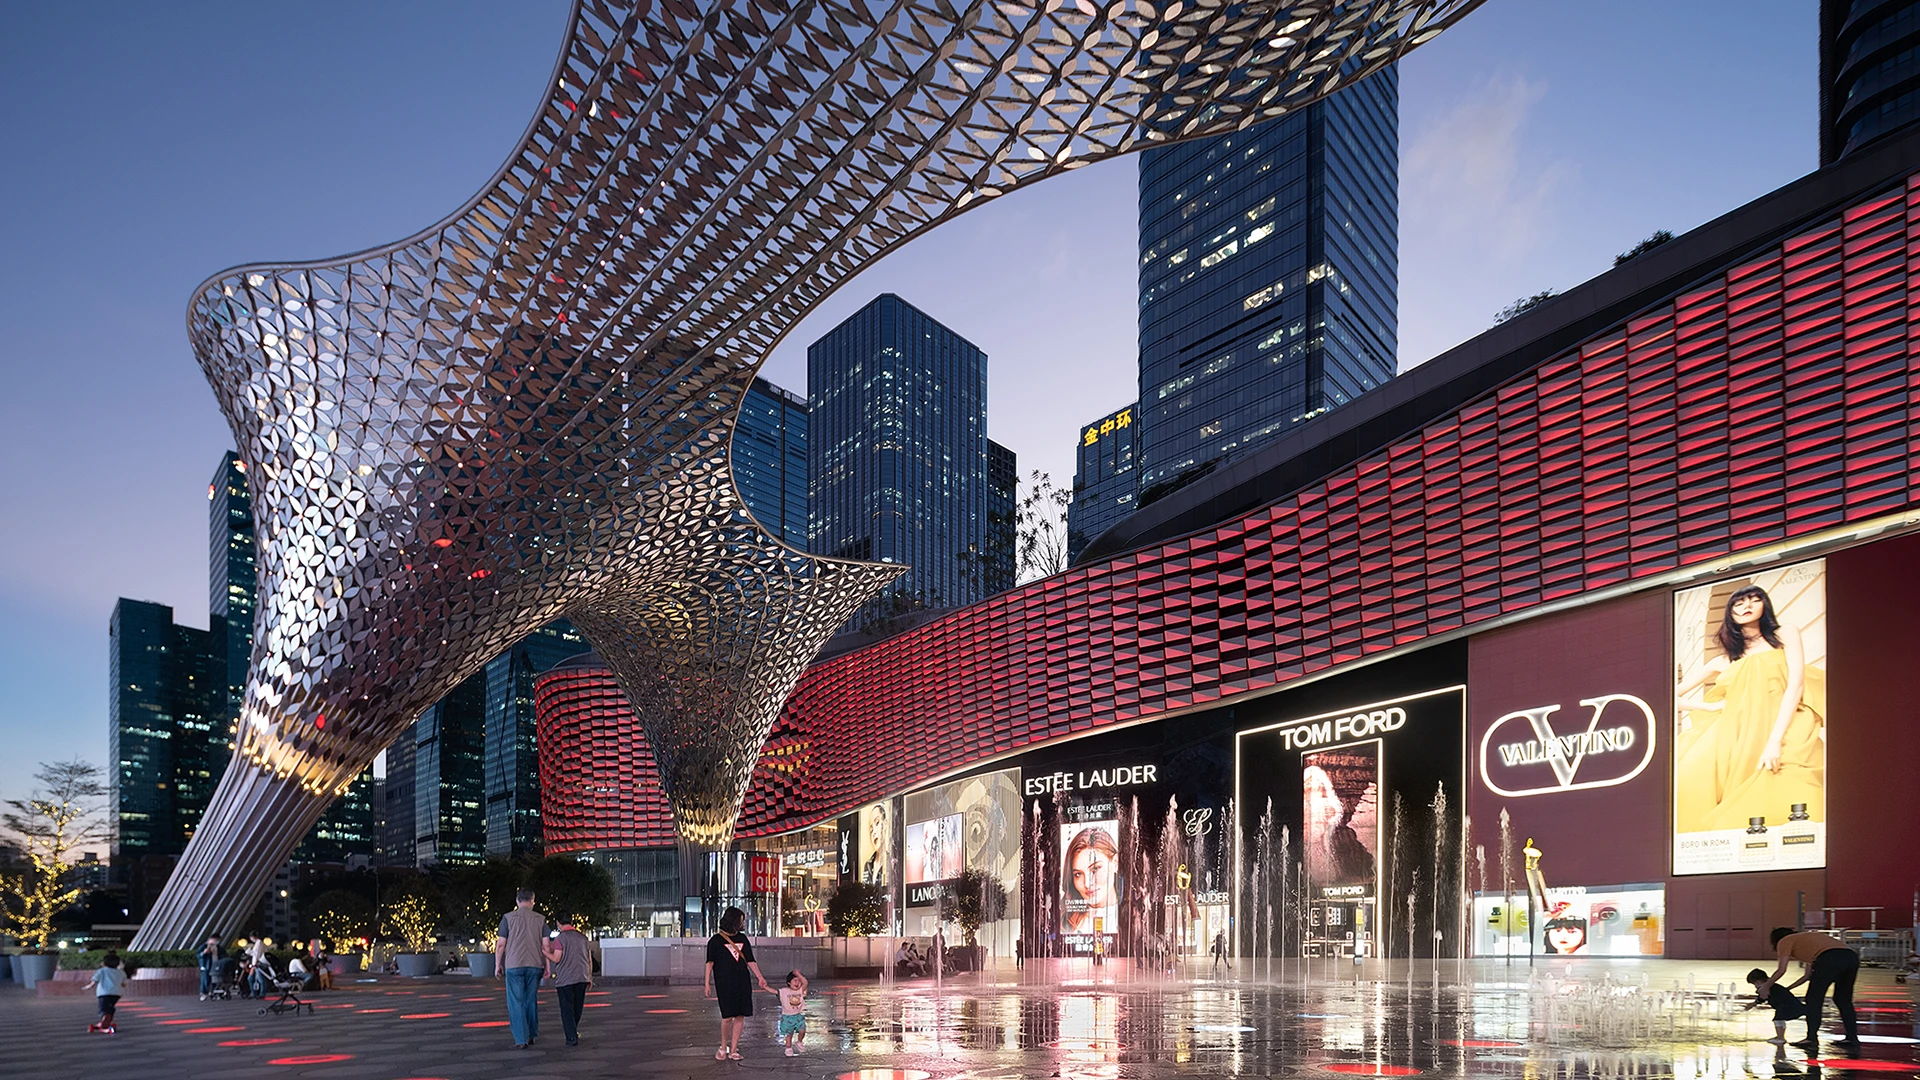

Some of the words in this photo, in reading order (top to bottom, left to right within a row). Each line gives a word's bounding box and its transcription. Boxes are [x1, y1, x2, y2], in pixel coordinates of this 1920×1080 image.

[1084, 409, 1131, 446] 金中环
[1279, 721, 1331, 750] TOM
[1335, 707, 1407, 738] FORD
[1498, 726, 1635, 767] VALENTINO
[1079, 764, 1157, 789] LAUDER
[786, 849, 825, 865] 卓悦中心
[1323, 887, 1341, 896] TOM
[1342, 886, 1364, 895] FORD
